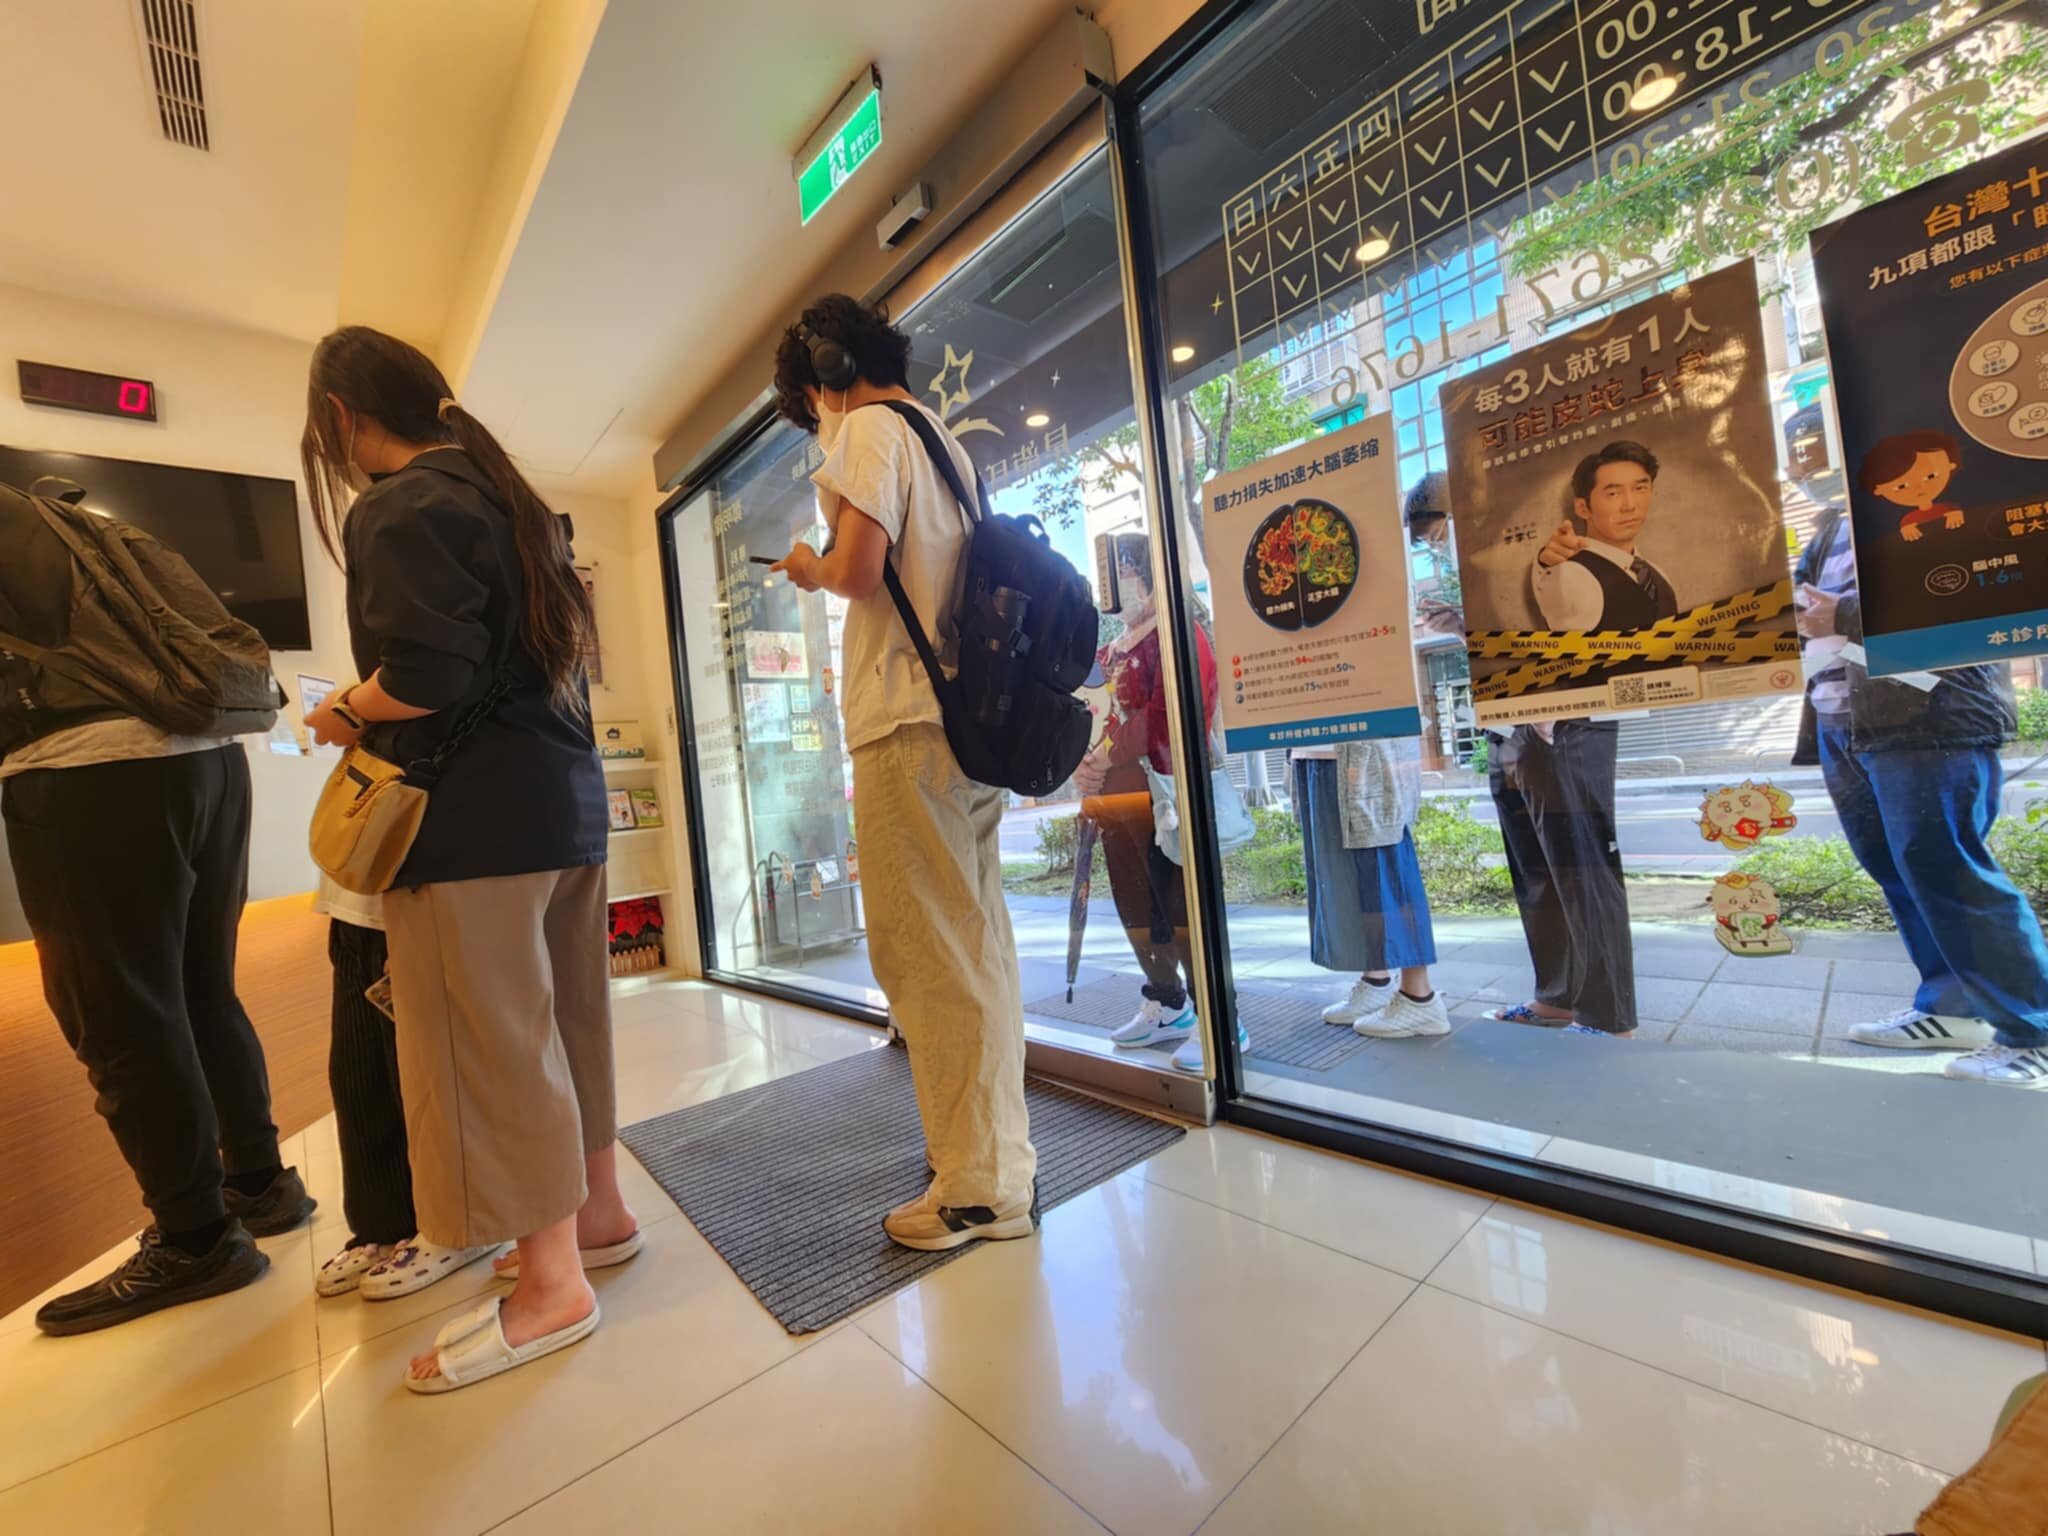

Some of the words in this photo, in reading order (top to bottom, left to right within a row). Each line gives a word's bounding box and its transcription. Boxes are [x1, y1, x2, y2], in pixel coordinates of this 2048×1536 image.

[852, 133, 876, 163] EXIT
[1474, 306, 1711, 413] 每3人就有1人
[118, 381, 149, 413] 0
[1213, 437, 1380, 513] 聽力損失加速大腦萎縮
[2008, 519, 2048, 537] 會大
[1972, 553, 2020, 572] 腦中風
[1697, 601, 1761, 627] WARNING
[1510, 641, 1560, 650] WARNING
[1588, 641, 1642, 651] WARNING
[1674, 642, 1736, 652] WARNING
[1533, 658, 1585, 679] WARNING
